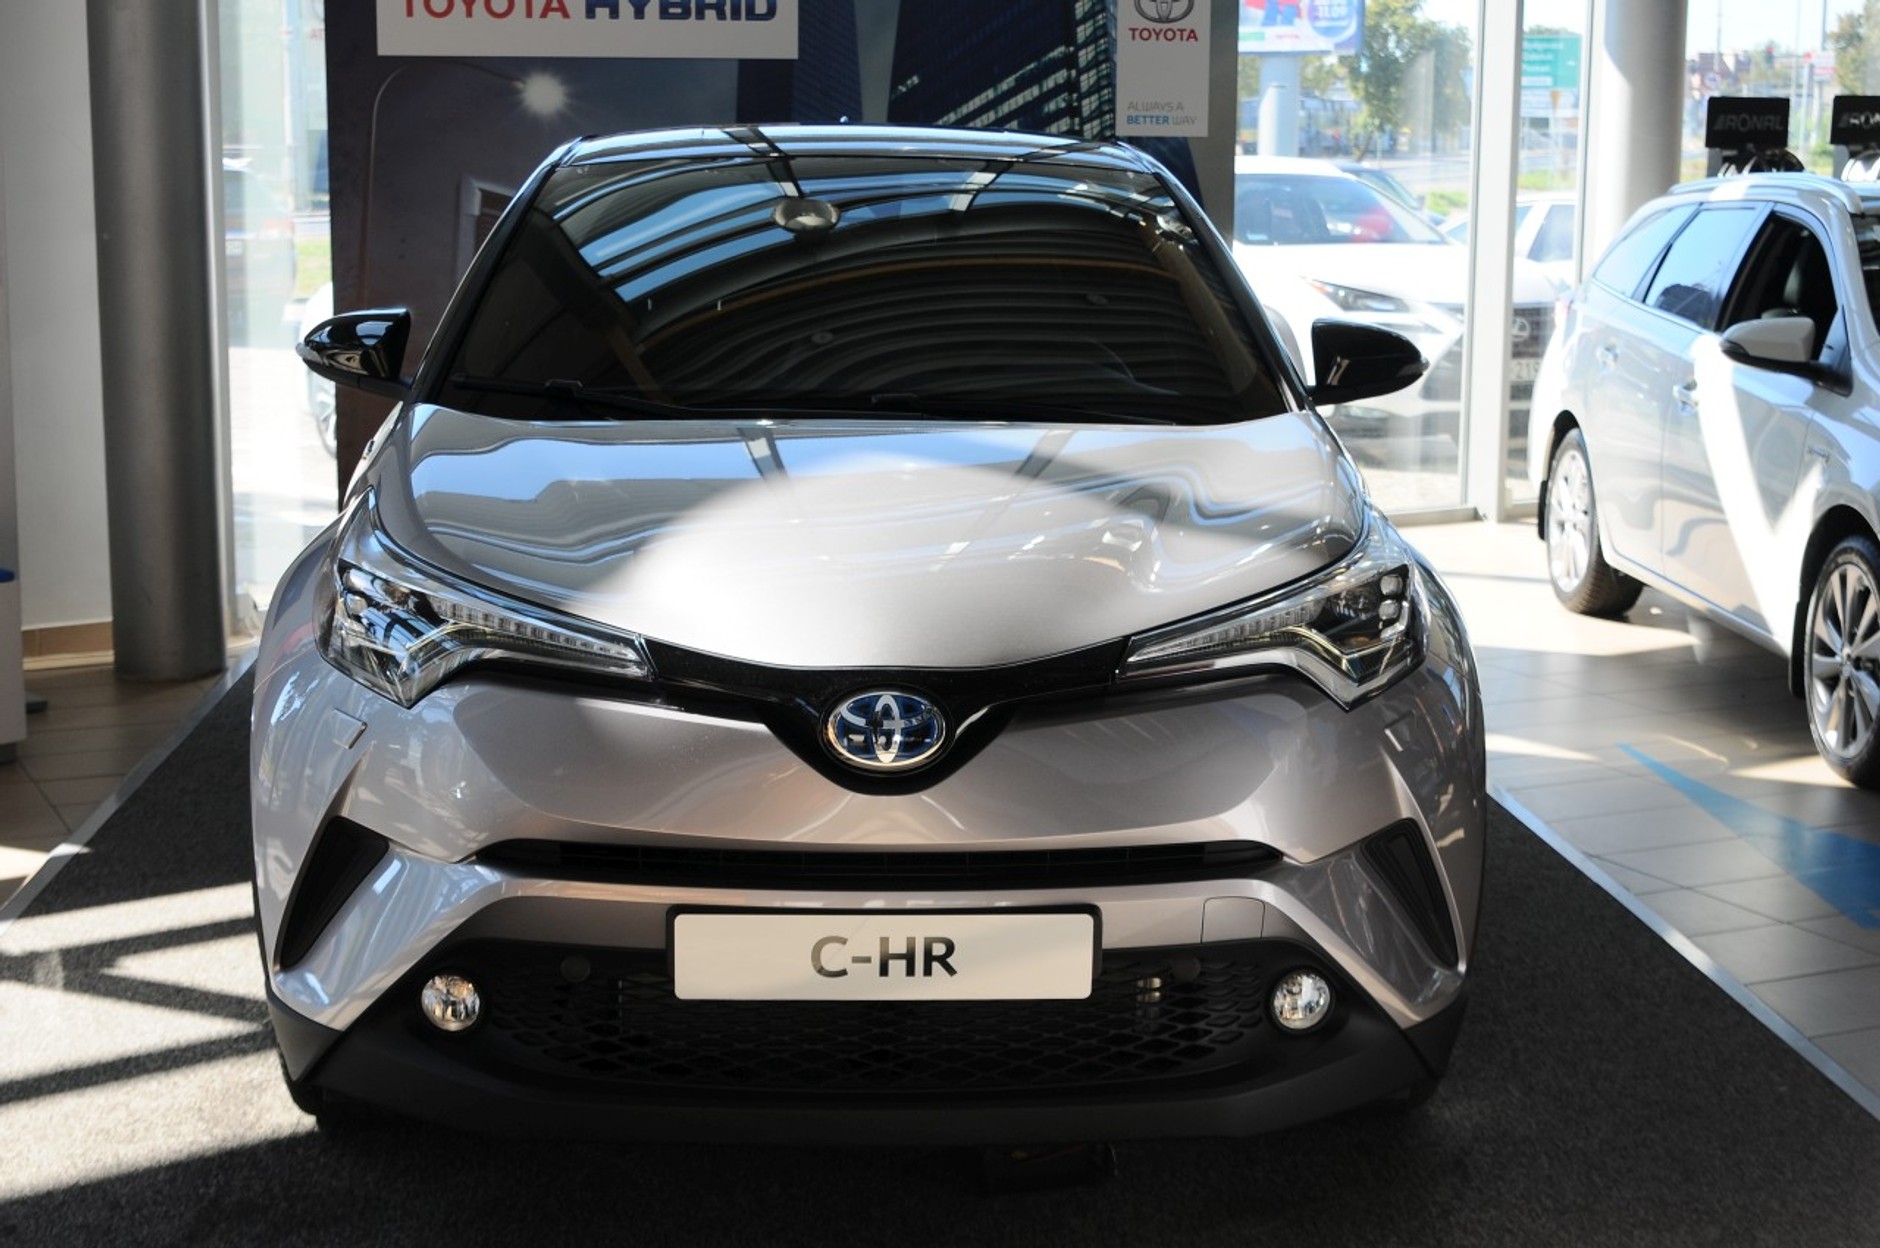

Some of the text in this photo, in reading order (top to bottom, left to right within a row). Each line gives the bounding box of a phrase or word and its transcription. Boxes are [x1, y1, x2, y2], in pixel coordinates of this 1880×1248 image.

[585, 0, 777, 21] HYBRID
[1128, 28, 1198, 41] TOYOTA
[1127, 101, 1184, 112] ALWAYS A
[1126, 115, 1197, 125] BETTER WAY
[810, 935, 957, 978] C-HR
